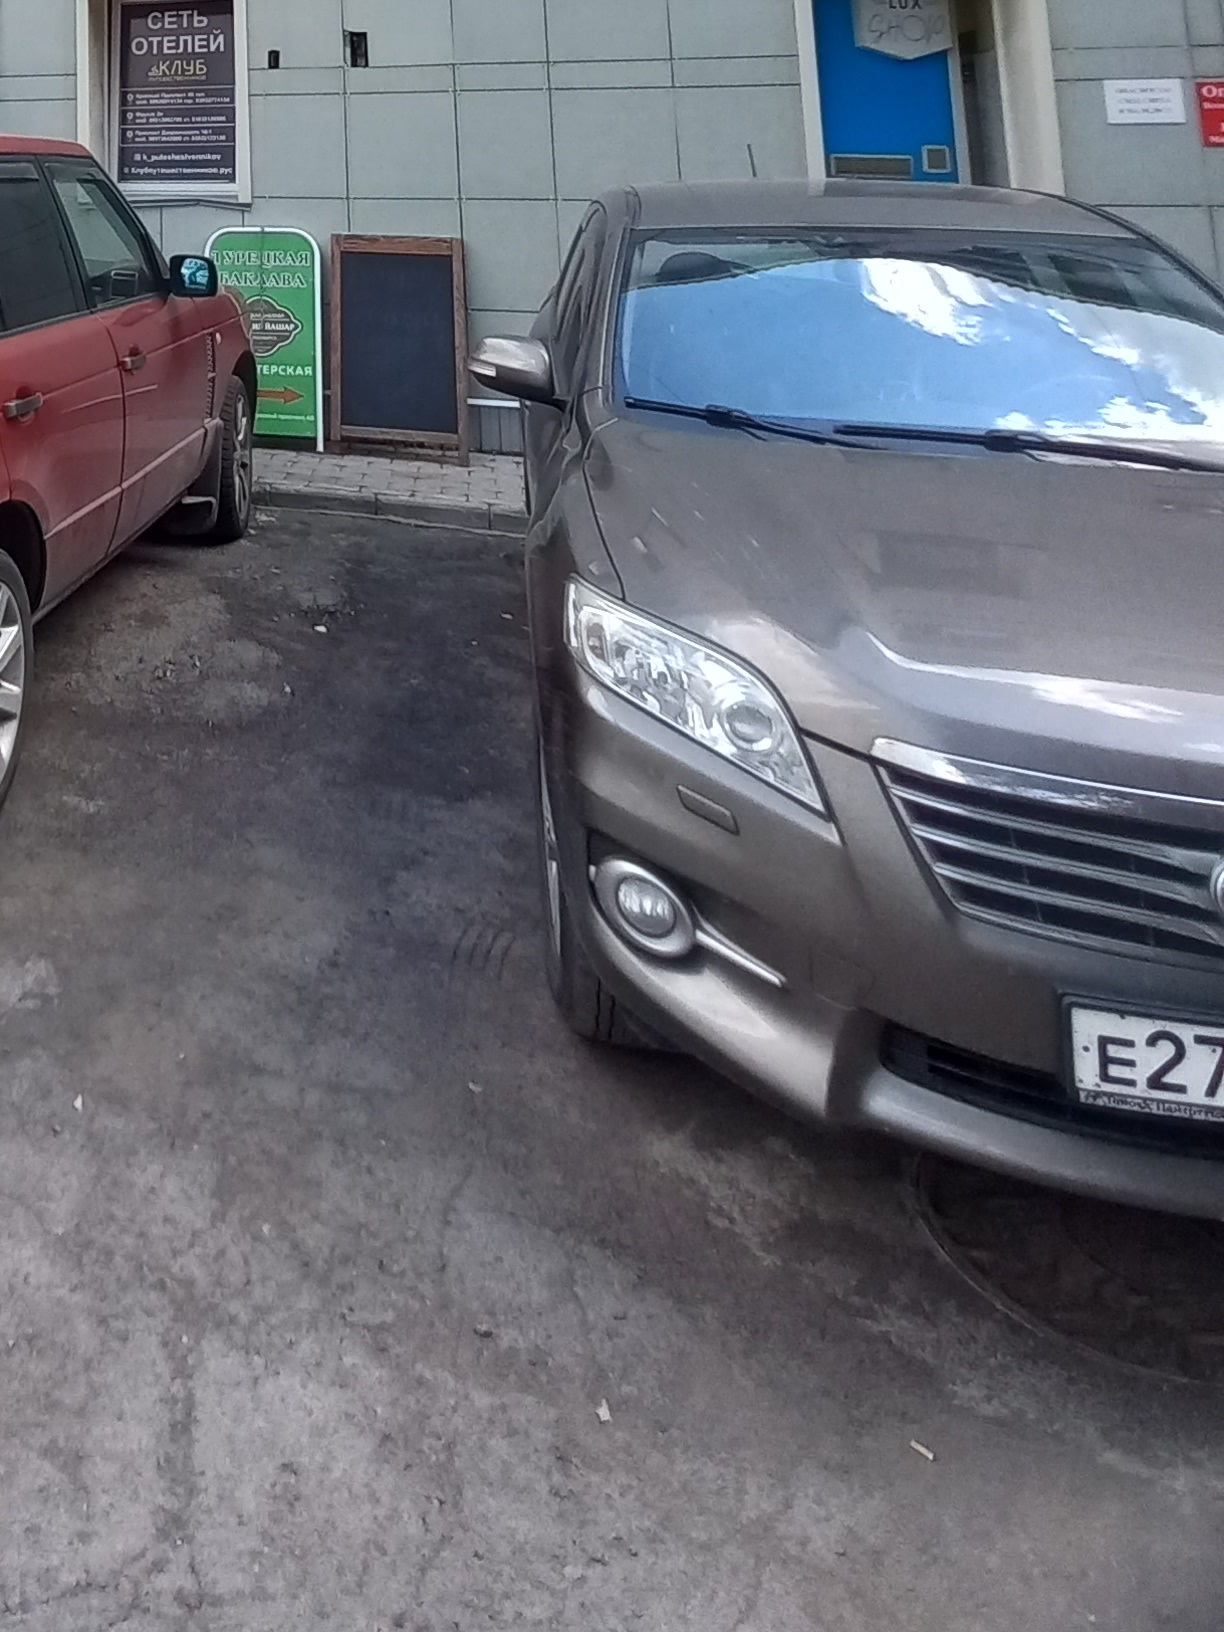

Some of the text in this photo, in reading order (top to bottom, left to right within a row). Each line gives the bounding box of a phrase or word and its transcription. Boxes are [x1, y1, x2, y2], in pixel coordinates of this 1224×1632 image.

[147, 10, 209, 30] СЕТЬ
[131, 29, 225, 56] ОТЕЛЕЙ
[159, 59, 207, 76] КЛУБ
[211, 250, 312, 269] ТУРЕЦКАЯ
[219, 271, 308, 288] БАКЛАВА
[257, 364, 313, 377] ТЕРСКАЯ
